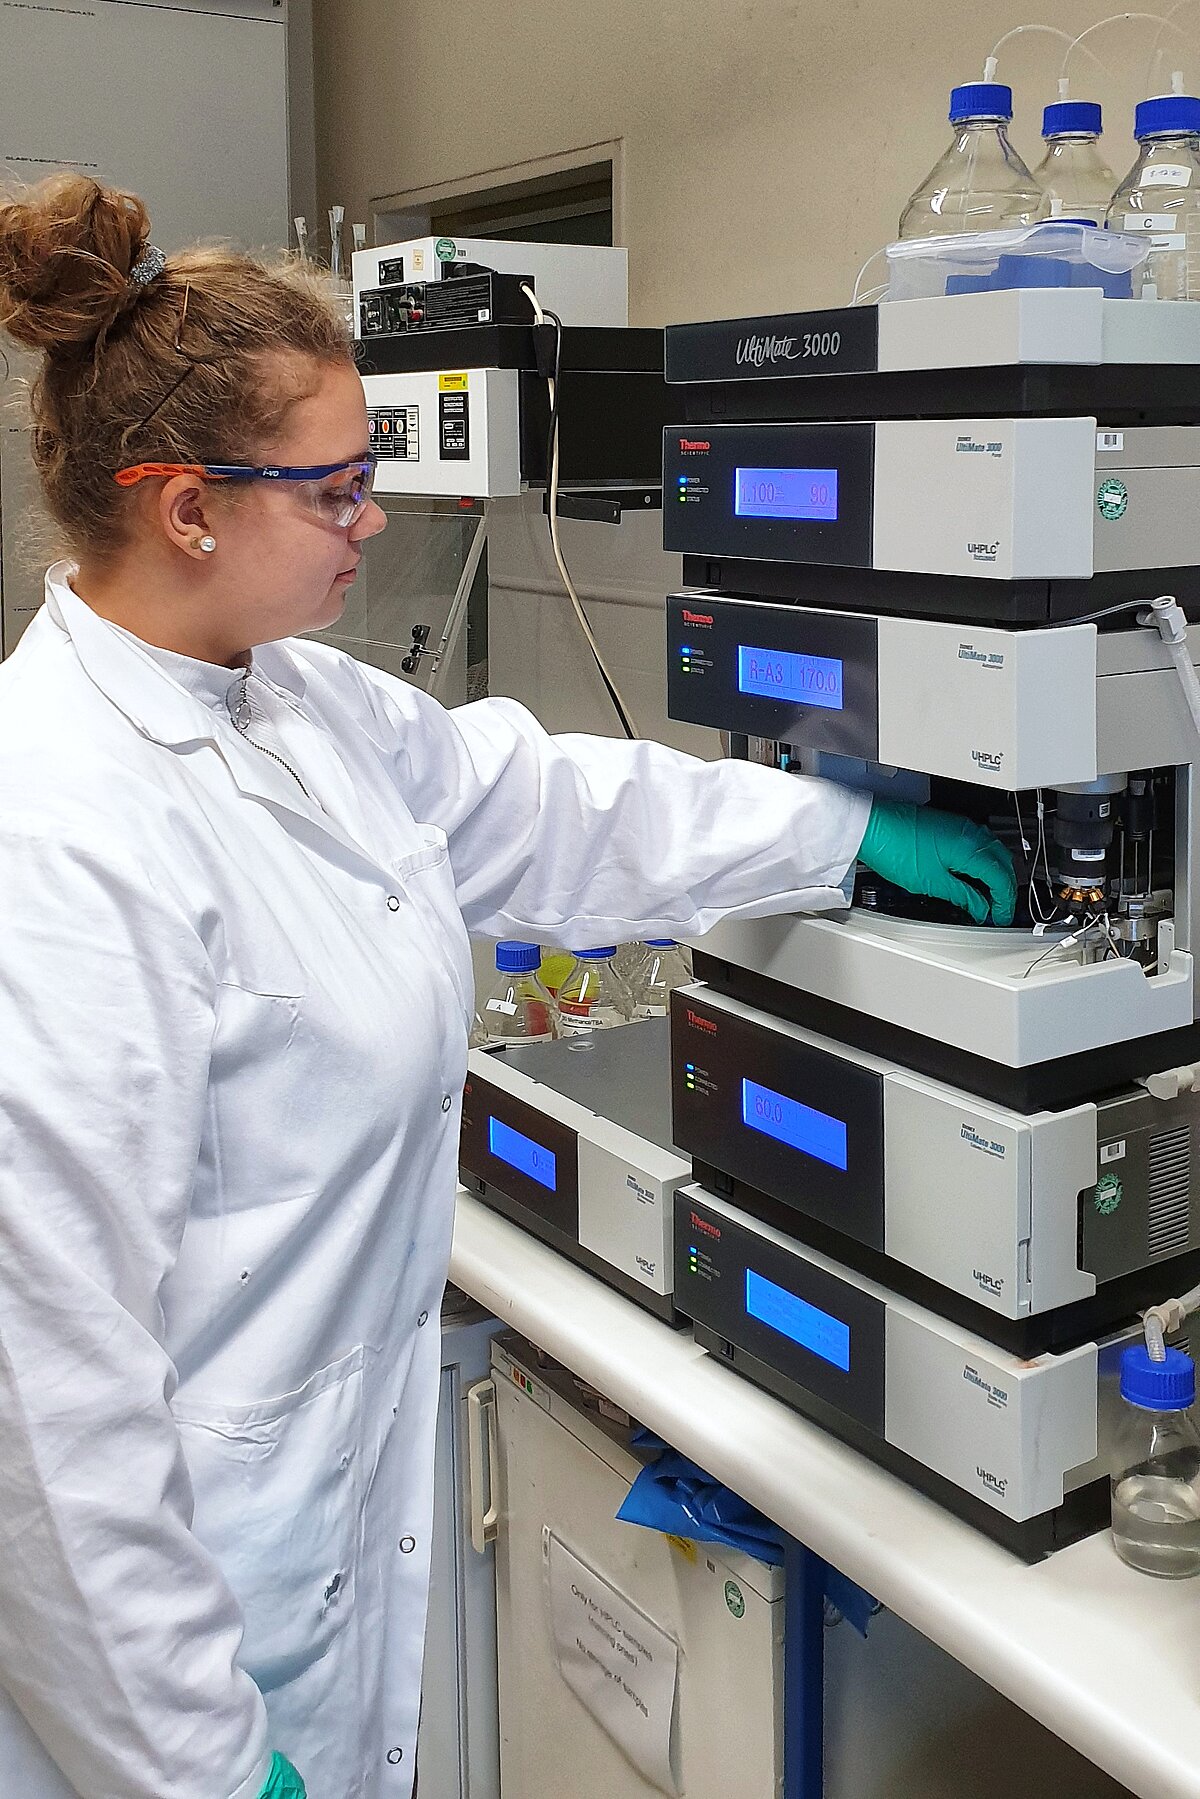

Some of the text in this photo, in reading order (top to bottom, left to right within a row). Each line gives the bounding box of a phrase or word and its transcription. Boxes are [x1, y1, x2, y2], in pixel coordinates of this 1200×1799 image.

[1143, 218, 1153, 229] C
[736, 331, 841, 367] UltiMate 3000
[679, 438, 710, 450] Thermo
[682, 609, 714, 625] Thermo
[749, 658, 783, 684] R-A3
[800, 666, 837, 692] 170.0
[686, 1009, 718, 1032] Thermo
[690, 1211, 721, 1238] Thermo
